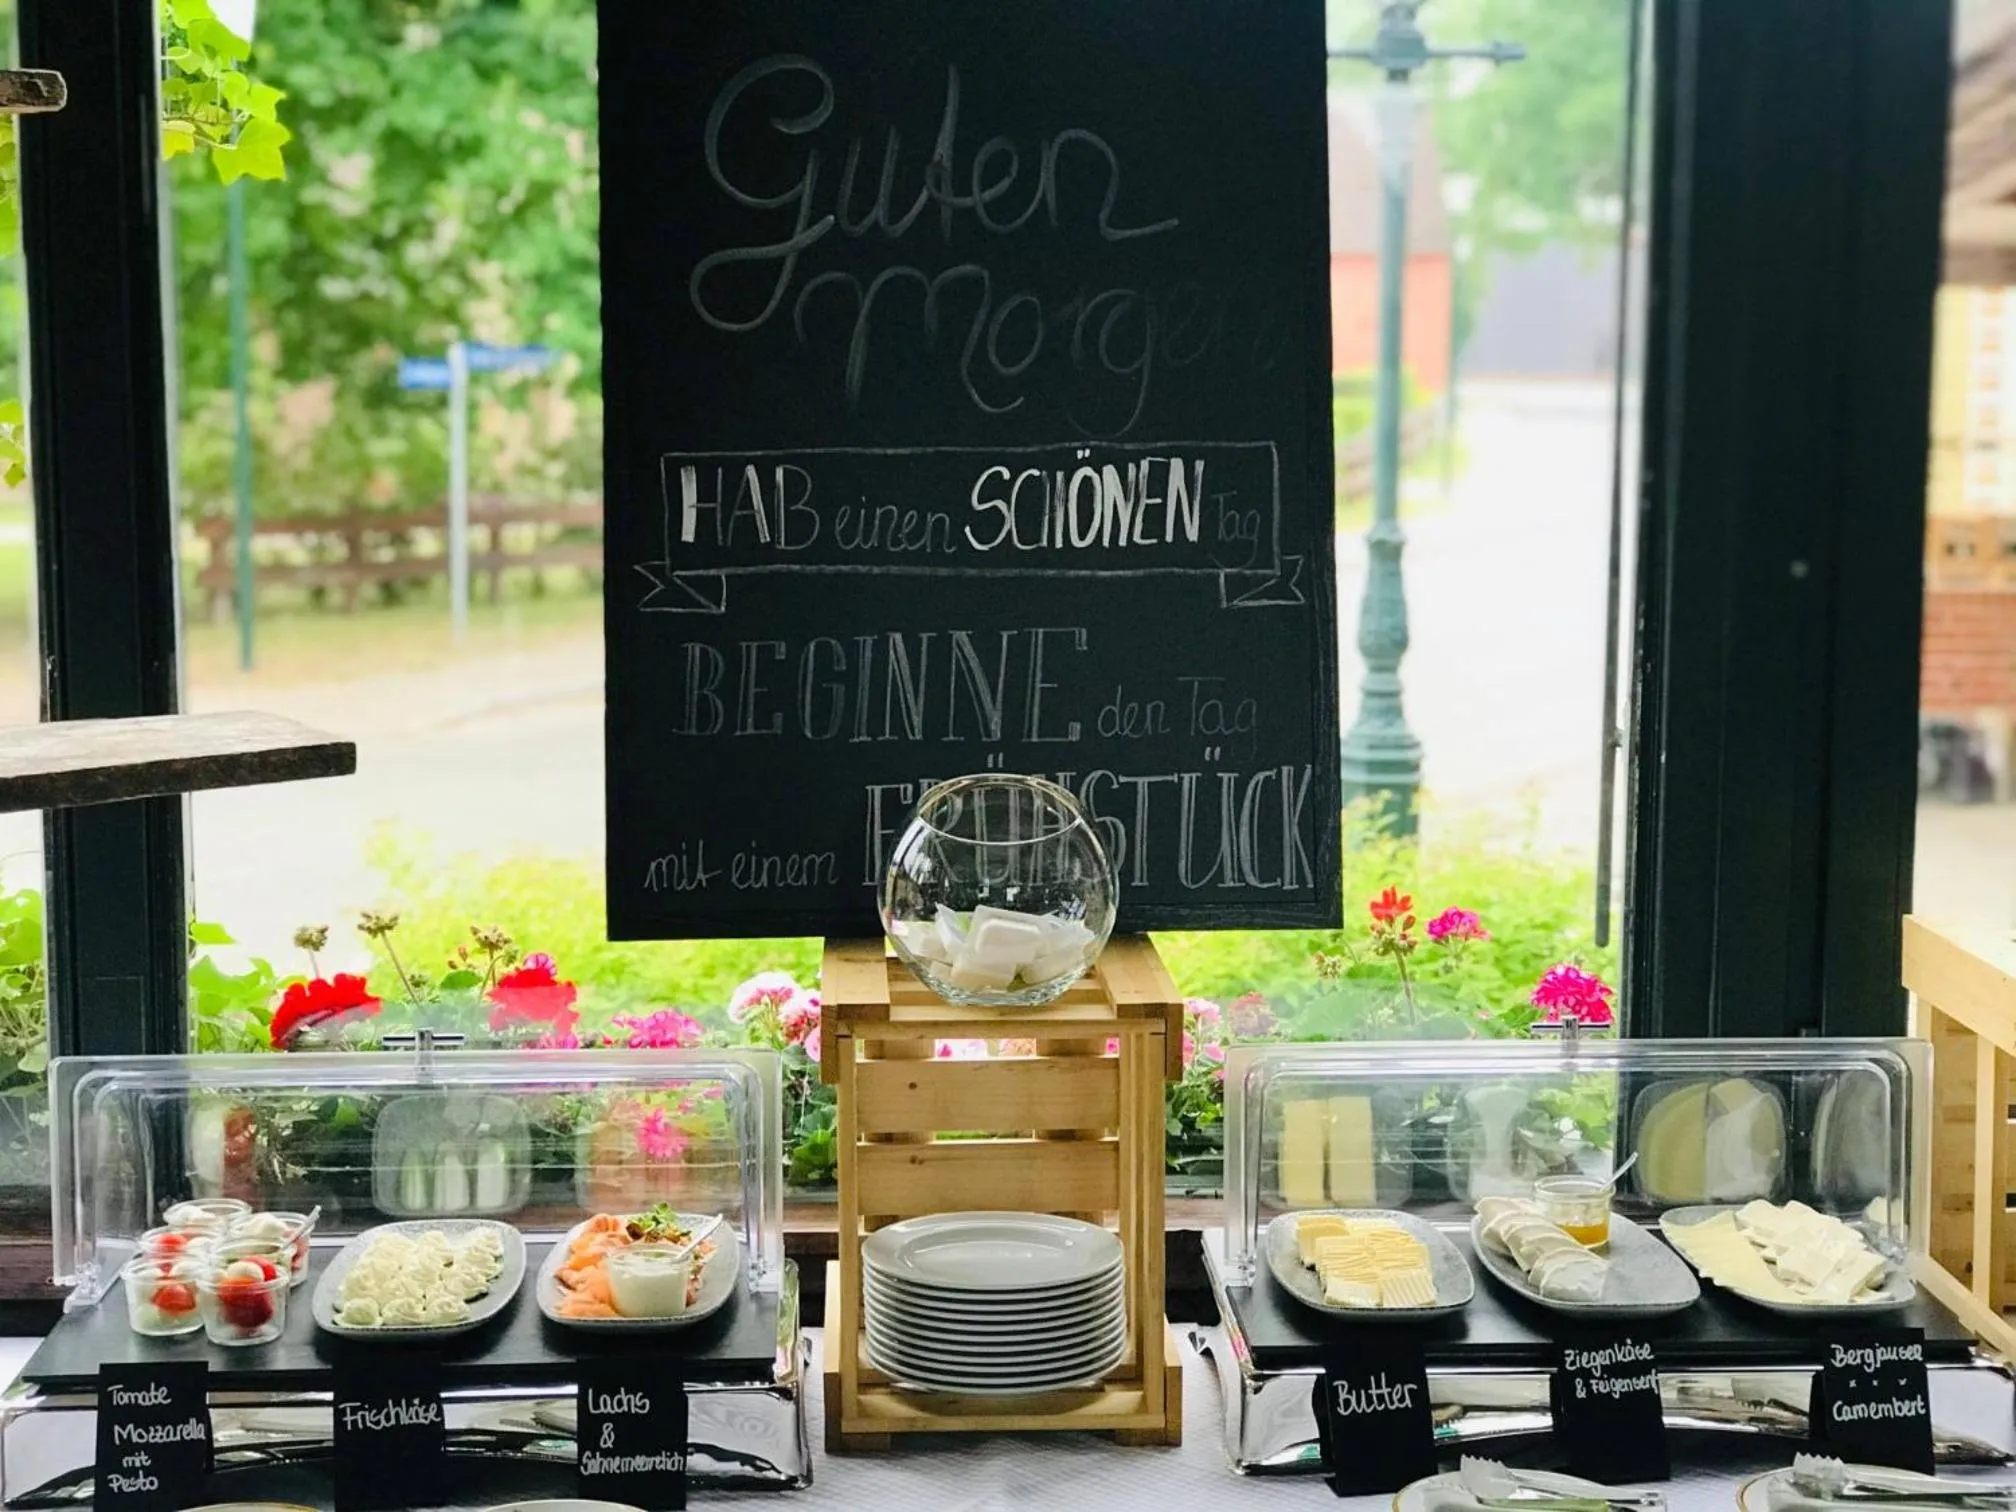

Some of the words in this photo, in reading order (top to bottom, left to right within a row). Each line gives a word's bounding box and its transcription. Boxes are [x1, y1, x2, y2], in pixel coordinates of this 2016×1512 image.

[691, 54, 1178, 331] Guten
[681, 464, 821, 550] HAB
[834, 499, 956, 553] einen
[964, 448, 1204, 553] SCHÖNEN
[1212, 491, 1261, 570] Tag
[672, 627, 1089, 743] BEGINNE
[1098, 684, 1170, 738] den
[1177, 677, 1260, 762] Tag
[645, 840, 721, 892] mit
[730, 847, 838, 888] einem
[863, 747, 1316, 890] FRÜHSTÜCK
[1564, 1338, 1655, 1378] Ziegenkäse
[107, 1382, 172, 1406] Tomate
[1333, 1376, 1418, 1417] Butter
[1575, 1378, 1587, 1398] &
[1589, 1368, 1659, 1399] Feigensenf
[338, 1398, 442, 1431] Frischkäse
[588, 1387, 650, 1414] Lachs
[1832, 1394, 1927, 1422] Camembert
[114, 1417, 207, 1446] Mozzarella
[600, 1422, 615, 1448] &
[122, 1451, 152, 1469] mit
[107, 1473, 159, 1493] Pesto
